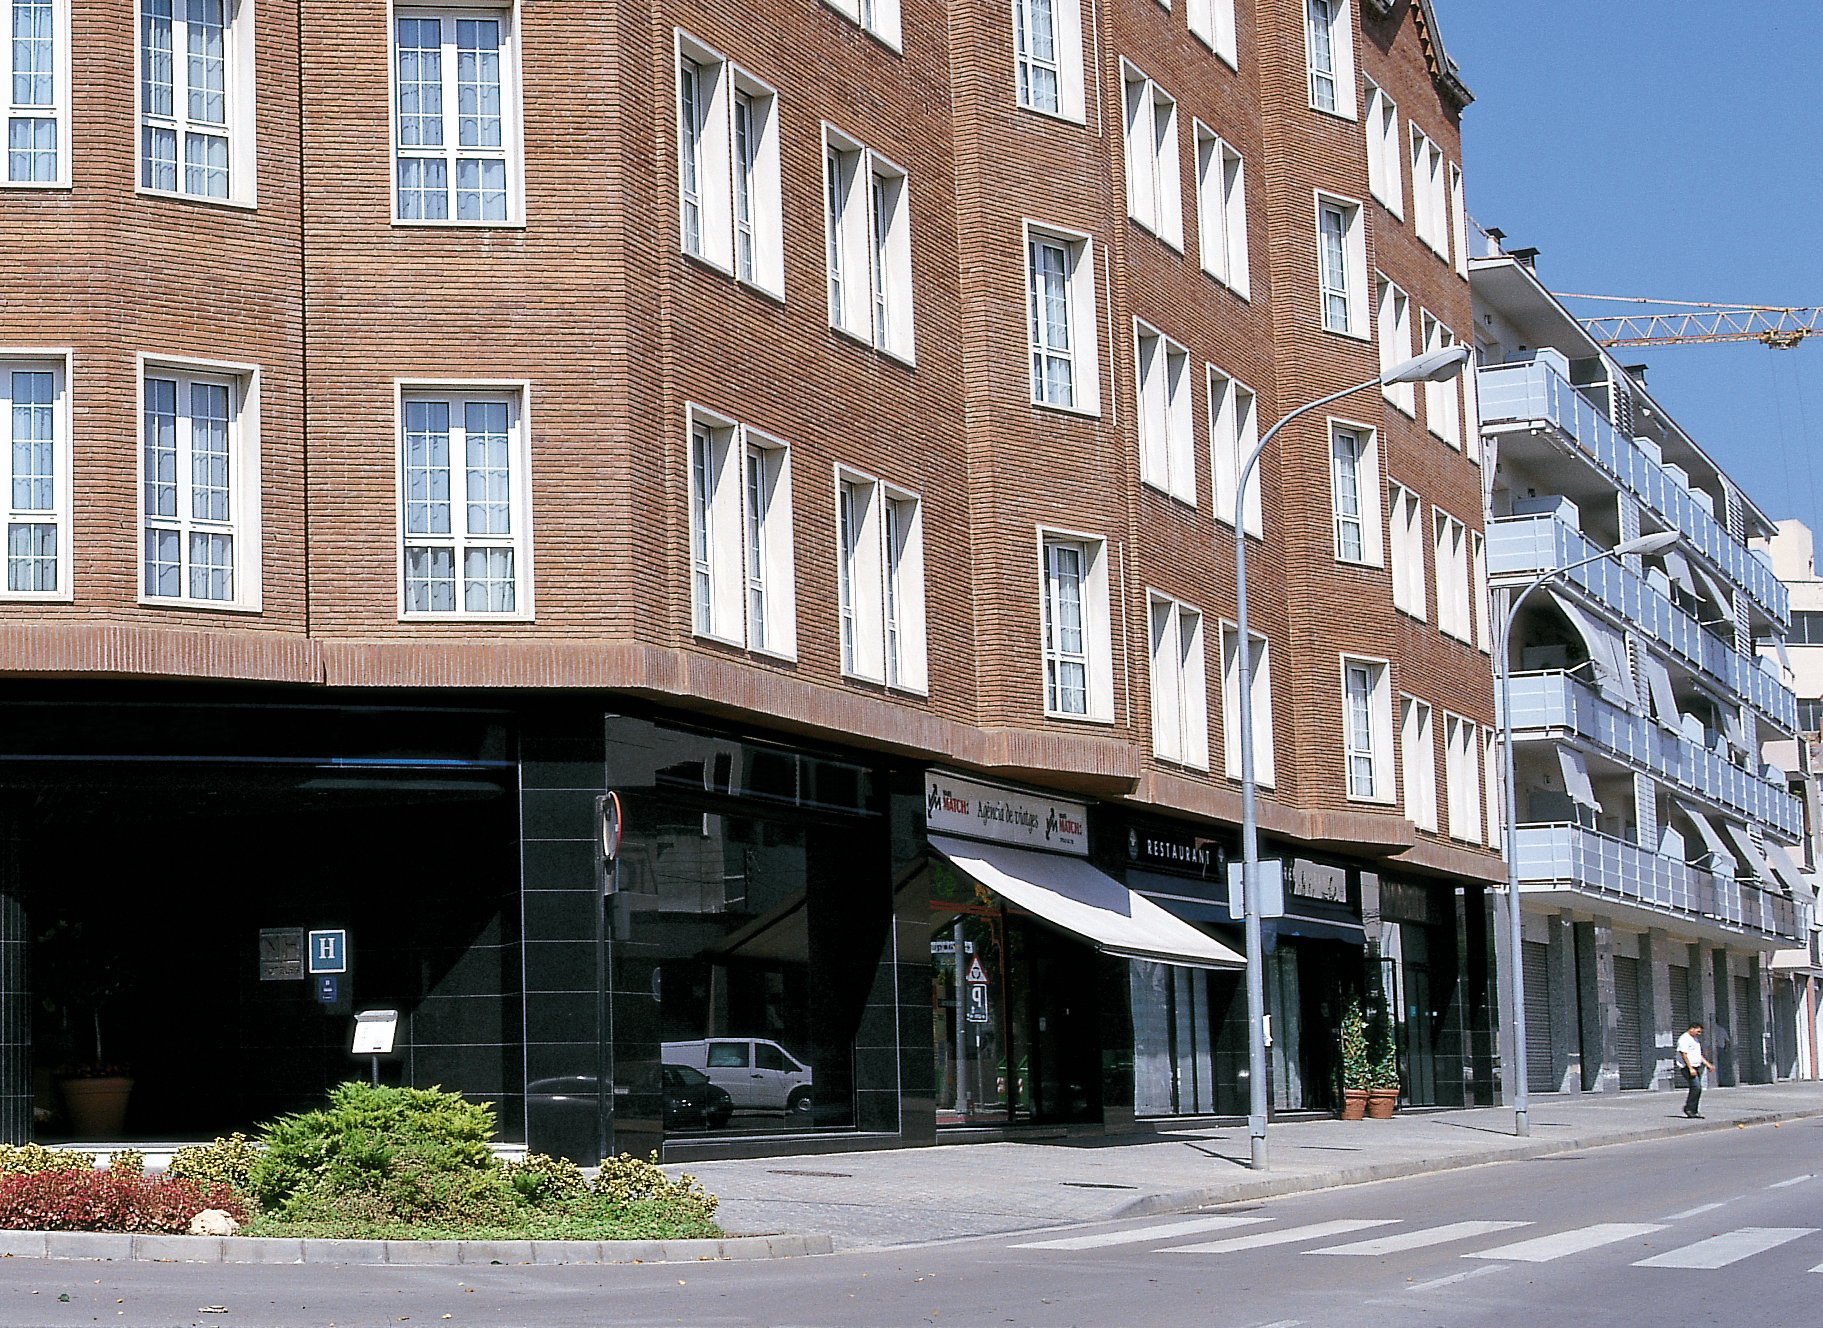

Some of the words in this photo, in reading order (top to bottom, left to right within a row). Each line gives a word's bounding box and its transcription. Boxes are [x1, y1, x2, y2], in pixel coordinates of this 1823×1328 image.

[1005, 803, 1013, 823] de
[1147, 839, 1210, 865] RESTAURANT
[319, 937, 336, 959] H
